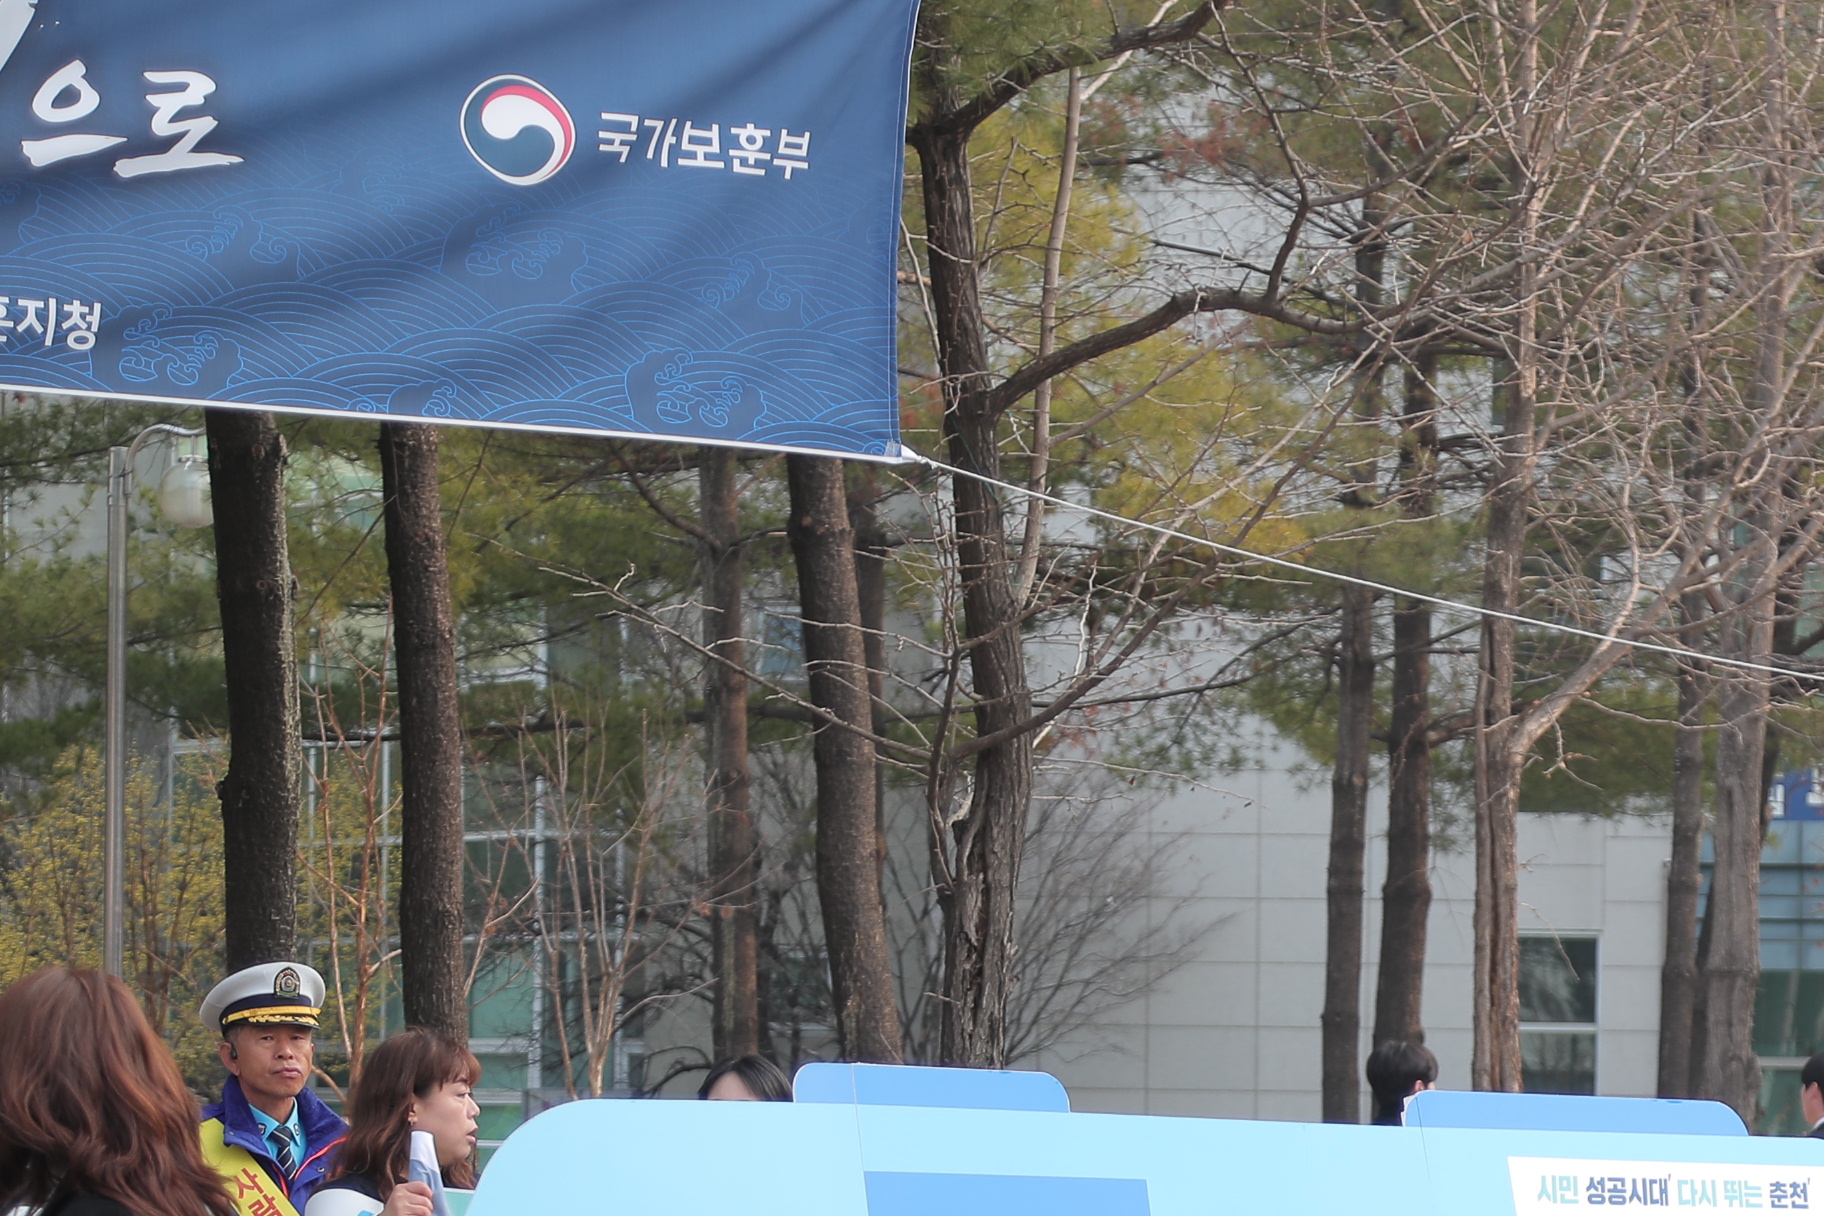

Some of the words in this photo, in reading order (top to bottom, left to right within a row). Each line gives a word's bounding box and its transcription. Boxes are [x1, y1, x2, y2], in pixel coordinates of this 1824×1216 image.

[20, 59, 245, 177] 으로
[598, 111, 811, 180] 국가보훈부
[1537, 1175, 1579, 1204] 시민
[1677, 1179, 1717, 1207] 다시
[1724, 1179, 1763, 1208] 뛰는
